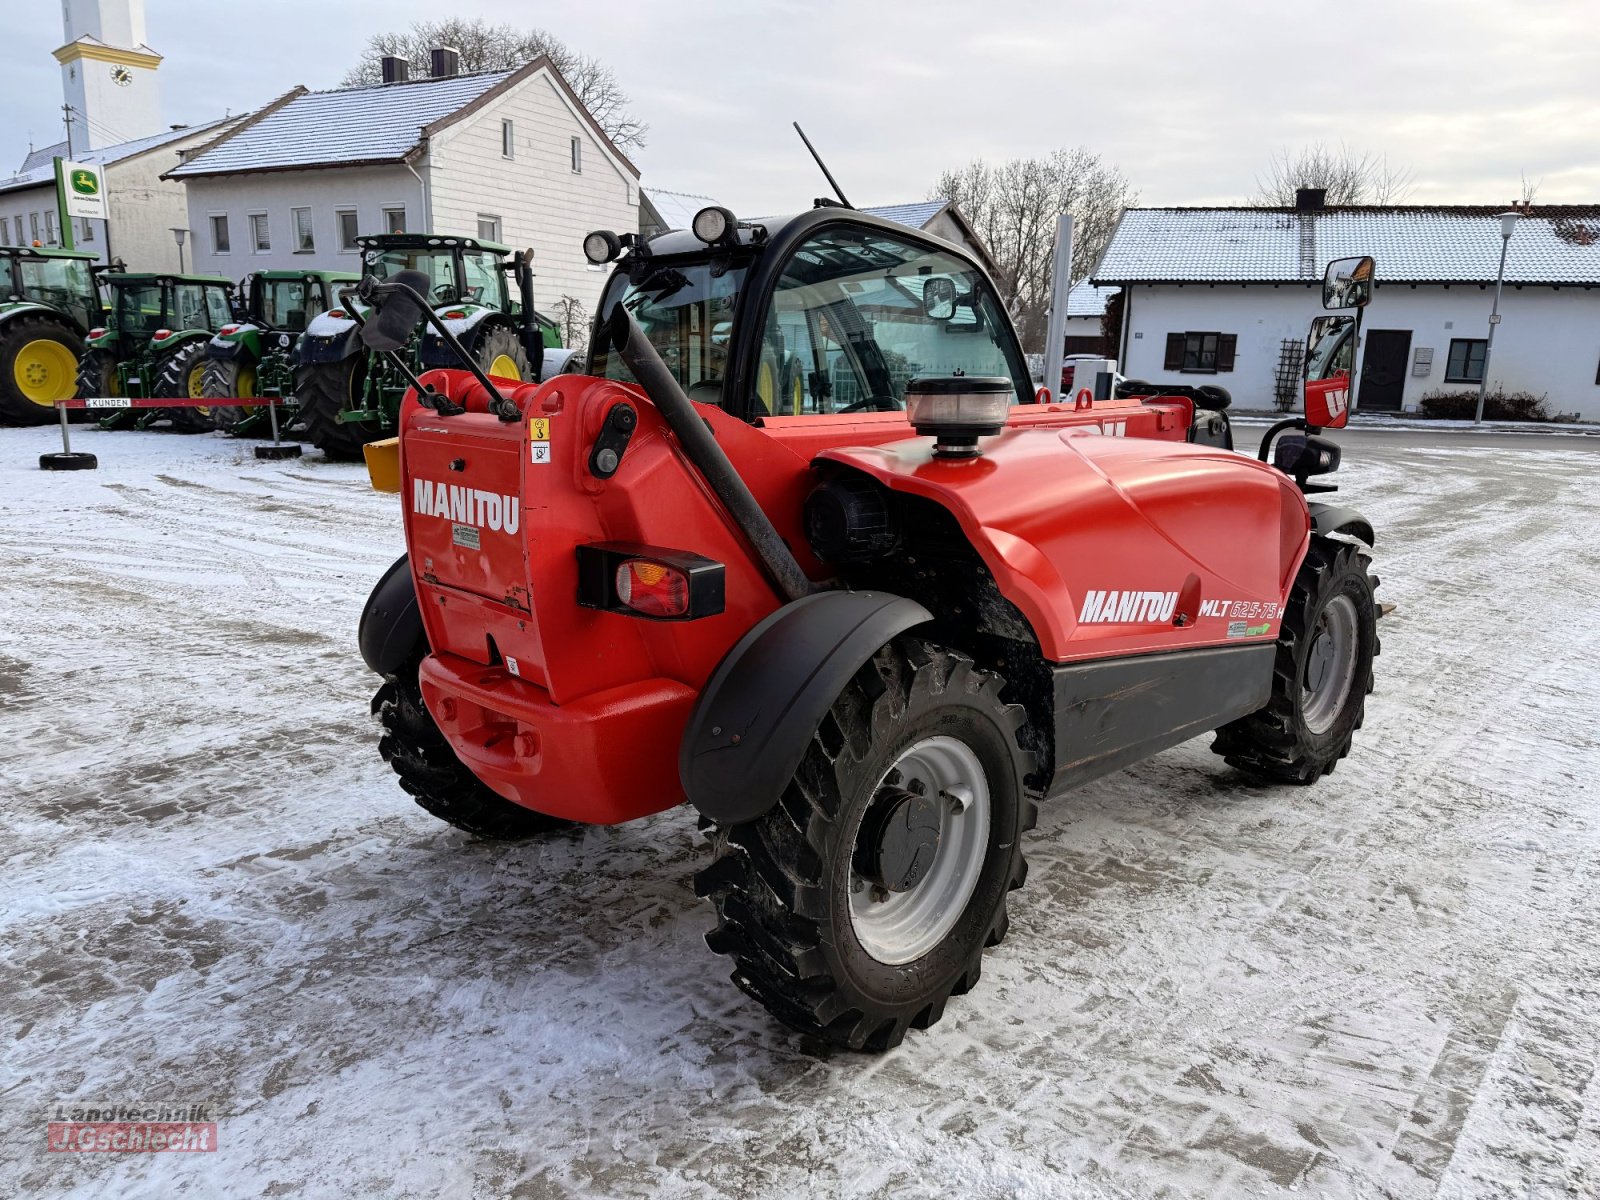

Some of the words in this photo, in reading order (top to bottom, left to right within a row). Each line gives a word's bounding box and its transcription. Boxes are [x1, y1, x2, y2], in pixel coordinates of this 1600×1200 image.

[92, 399, 128, 407] KUNDEN
[413, 478, 519, 535] MANITOU
[1078, 590, 1179, 622] MANITOU
[1198, 599, 1232, 617] MLT
[1230, 601, 1277, 619] 625-75
